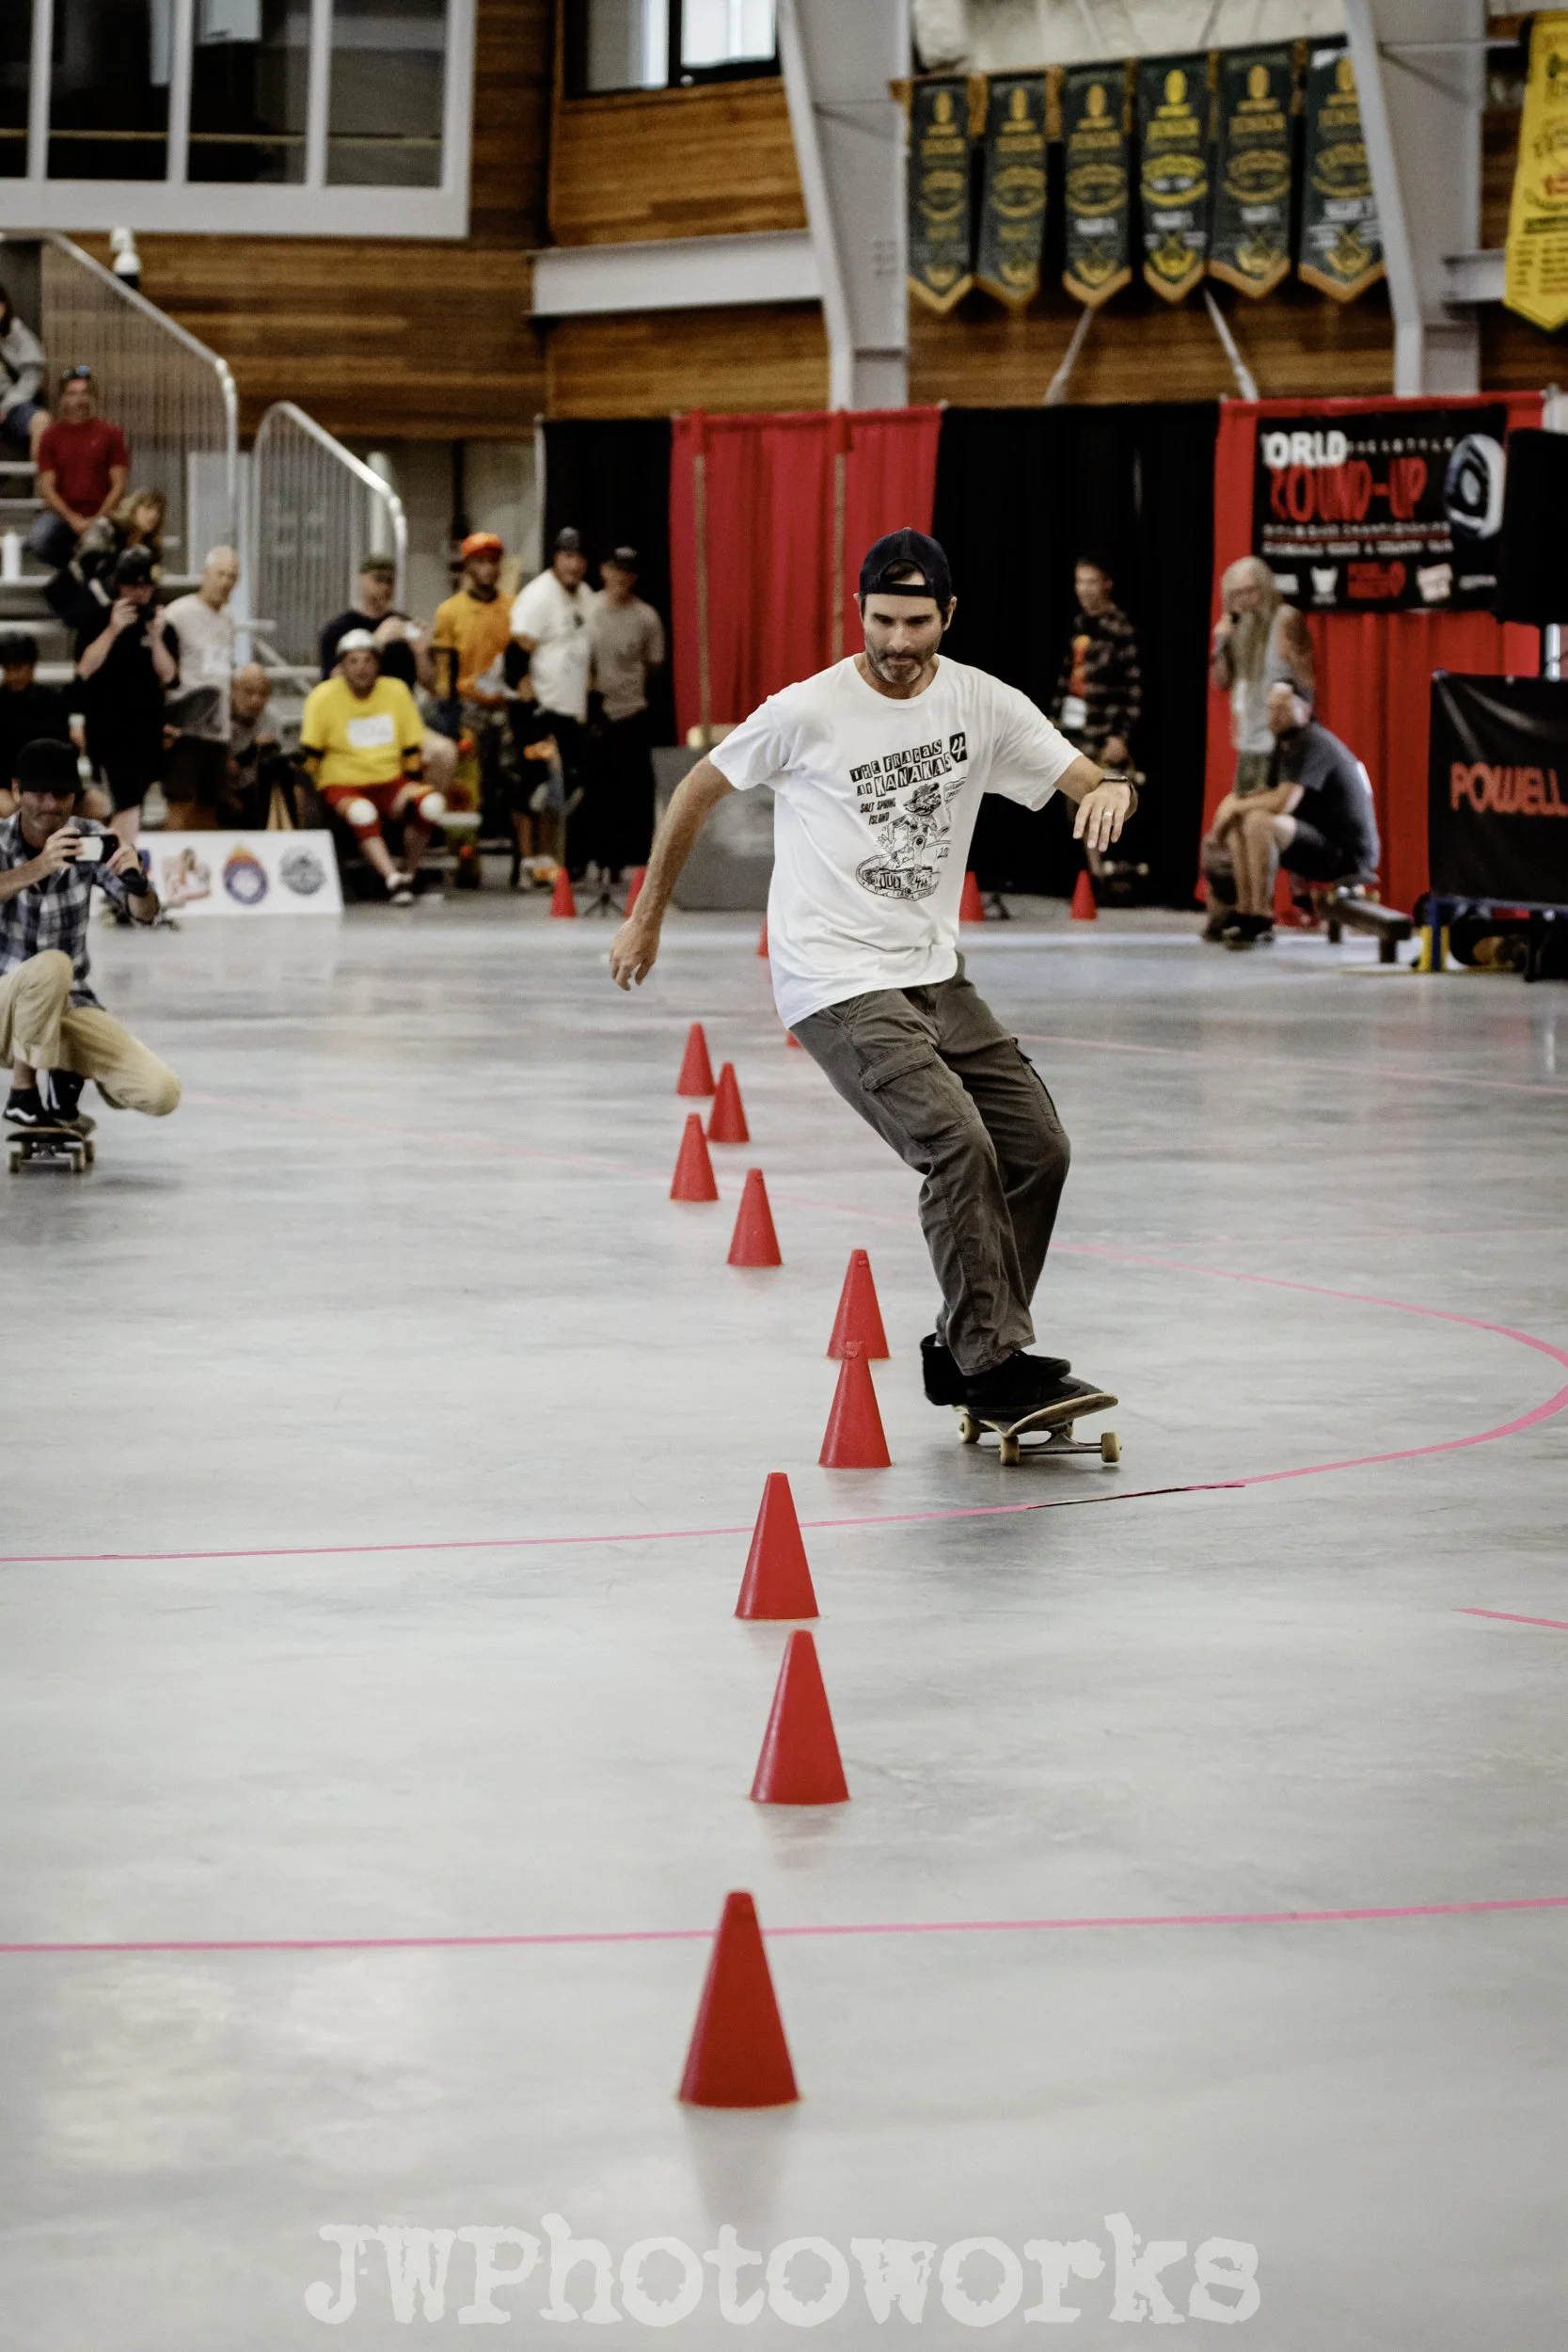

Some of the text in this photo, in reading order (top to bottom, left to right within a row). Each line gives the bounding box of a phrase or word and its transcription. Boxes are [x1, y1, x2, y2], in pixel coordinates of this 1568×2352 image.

[1260, 430, 1348, 469] ORLD
[849, 760, 881, 783] THE
[949, 732, 968, 763] 4
[874, 751, 953, 797] KANAKAS
[860, 798, 896, 813] SALT SPRING
[868, 812, 890, 824] ISLAND
[879, 871, 902, 889] JULY
